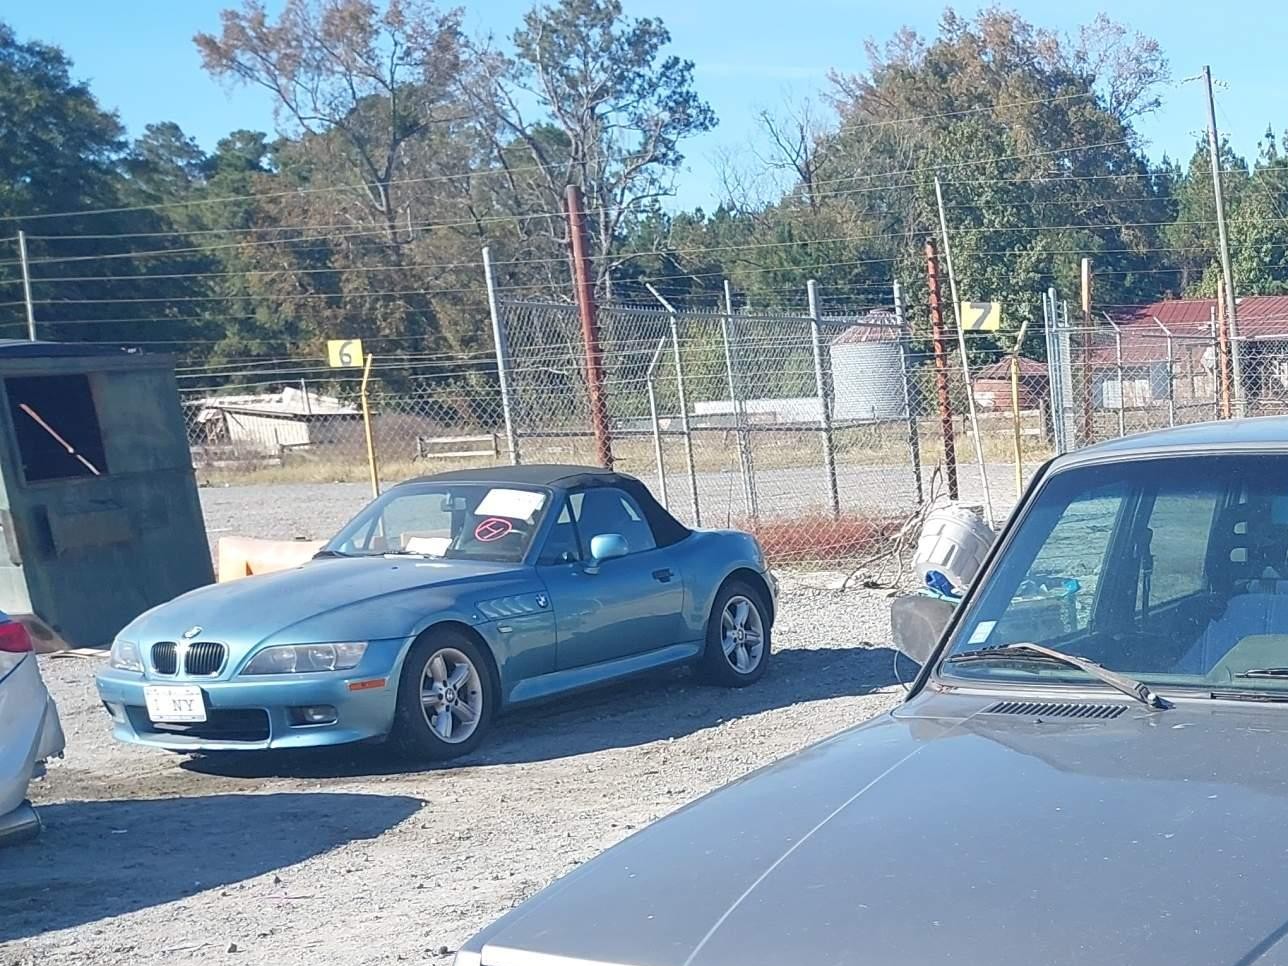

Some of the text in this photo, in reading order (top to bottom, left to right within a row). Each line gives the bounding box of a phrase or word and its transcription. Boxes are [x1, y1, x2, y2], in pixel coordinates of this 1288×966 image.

[970, 302, 992, 329] 7
[339, 341, 353, 367] 6
[172, 699, 195, 712] NY
